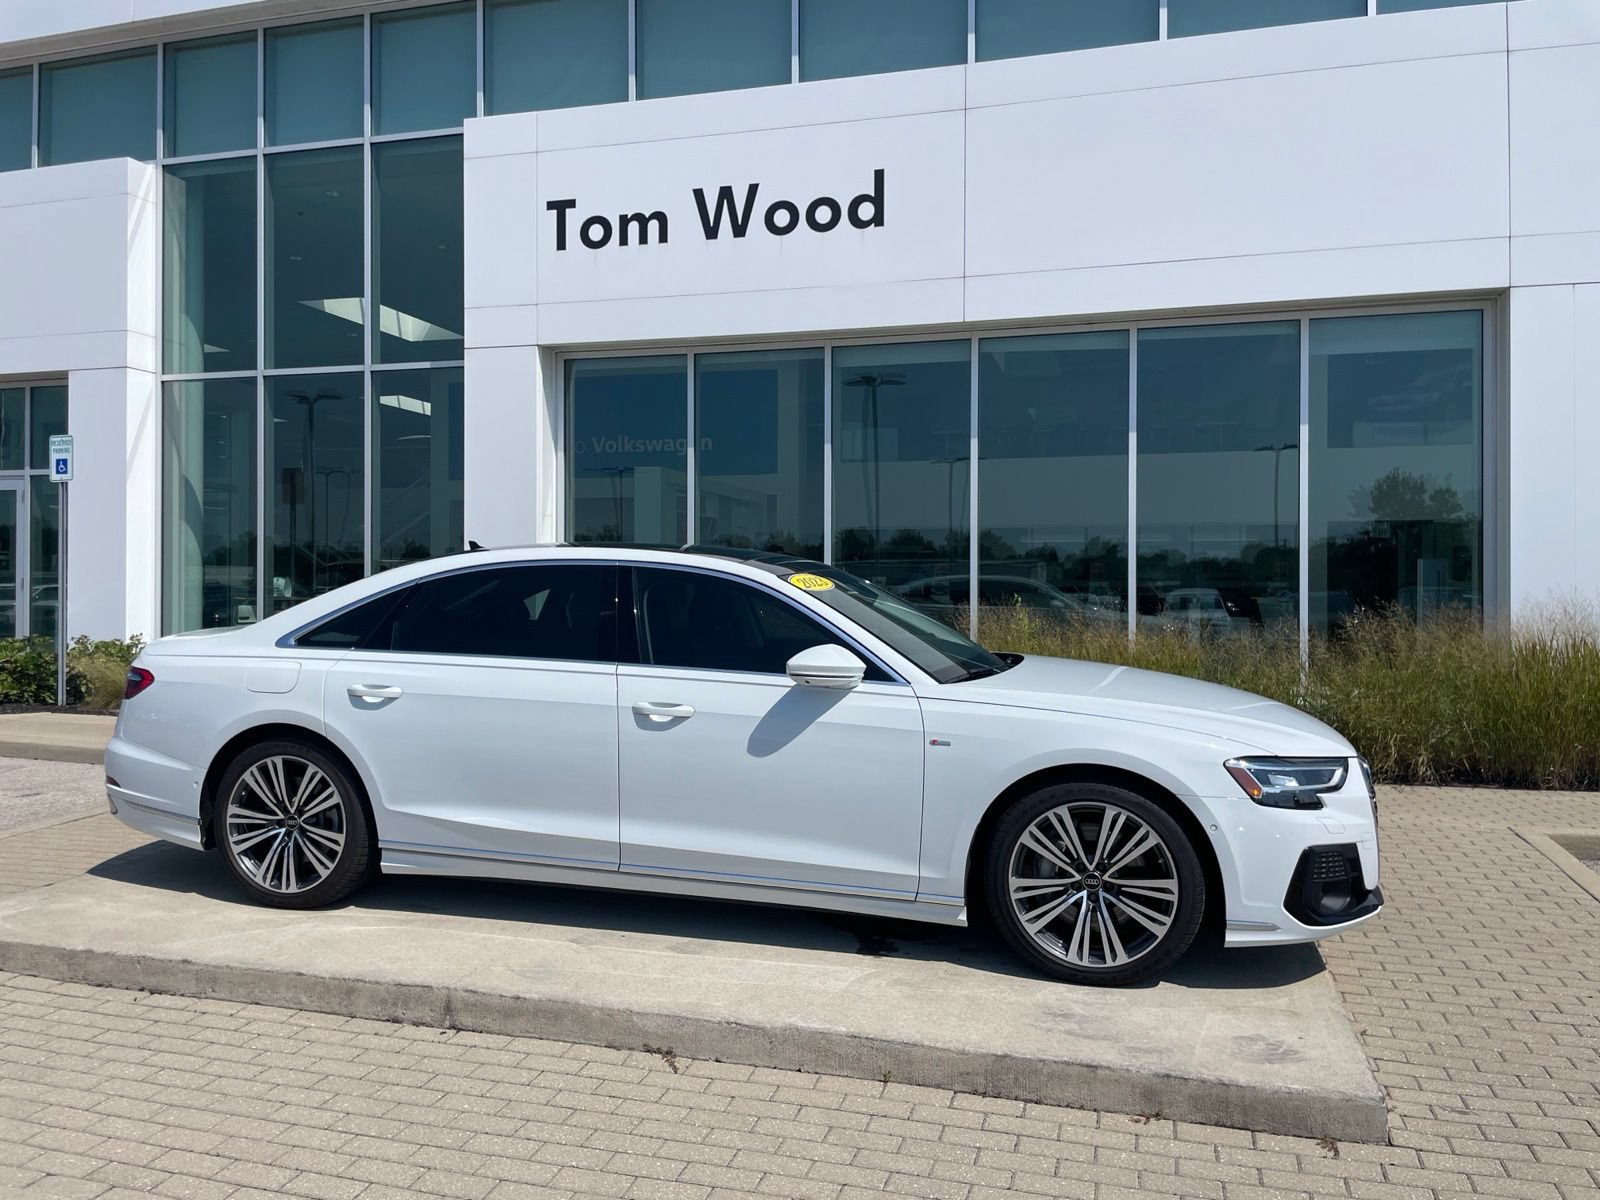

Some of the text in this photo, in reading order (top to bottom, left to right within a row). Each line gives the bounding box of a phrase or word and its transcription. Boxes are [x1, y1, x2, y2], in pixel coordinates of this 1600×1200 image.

[546, 168, 885, 252] Tom Wood
[592, 435, 713, 456] Volkswagn
